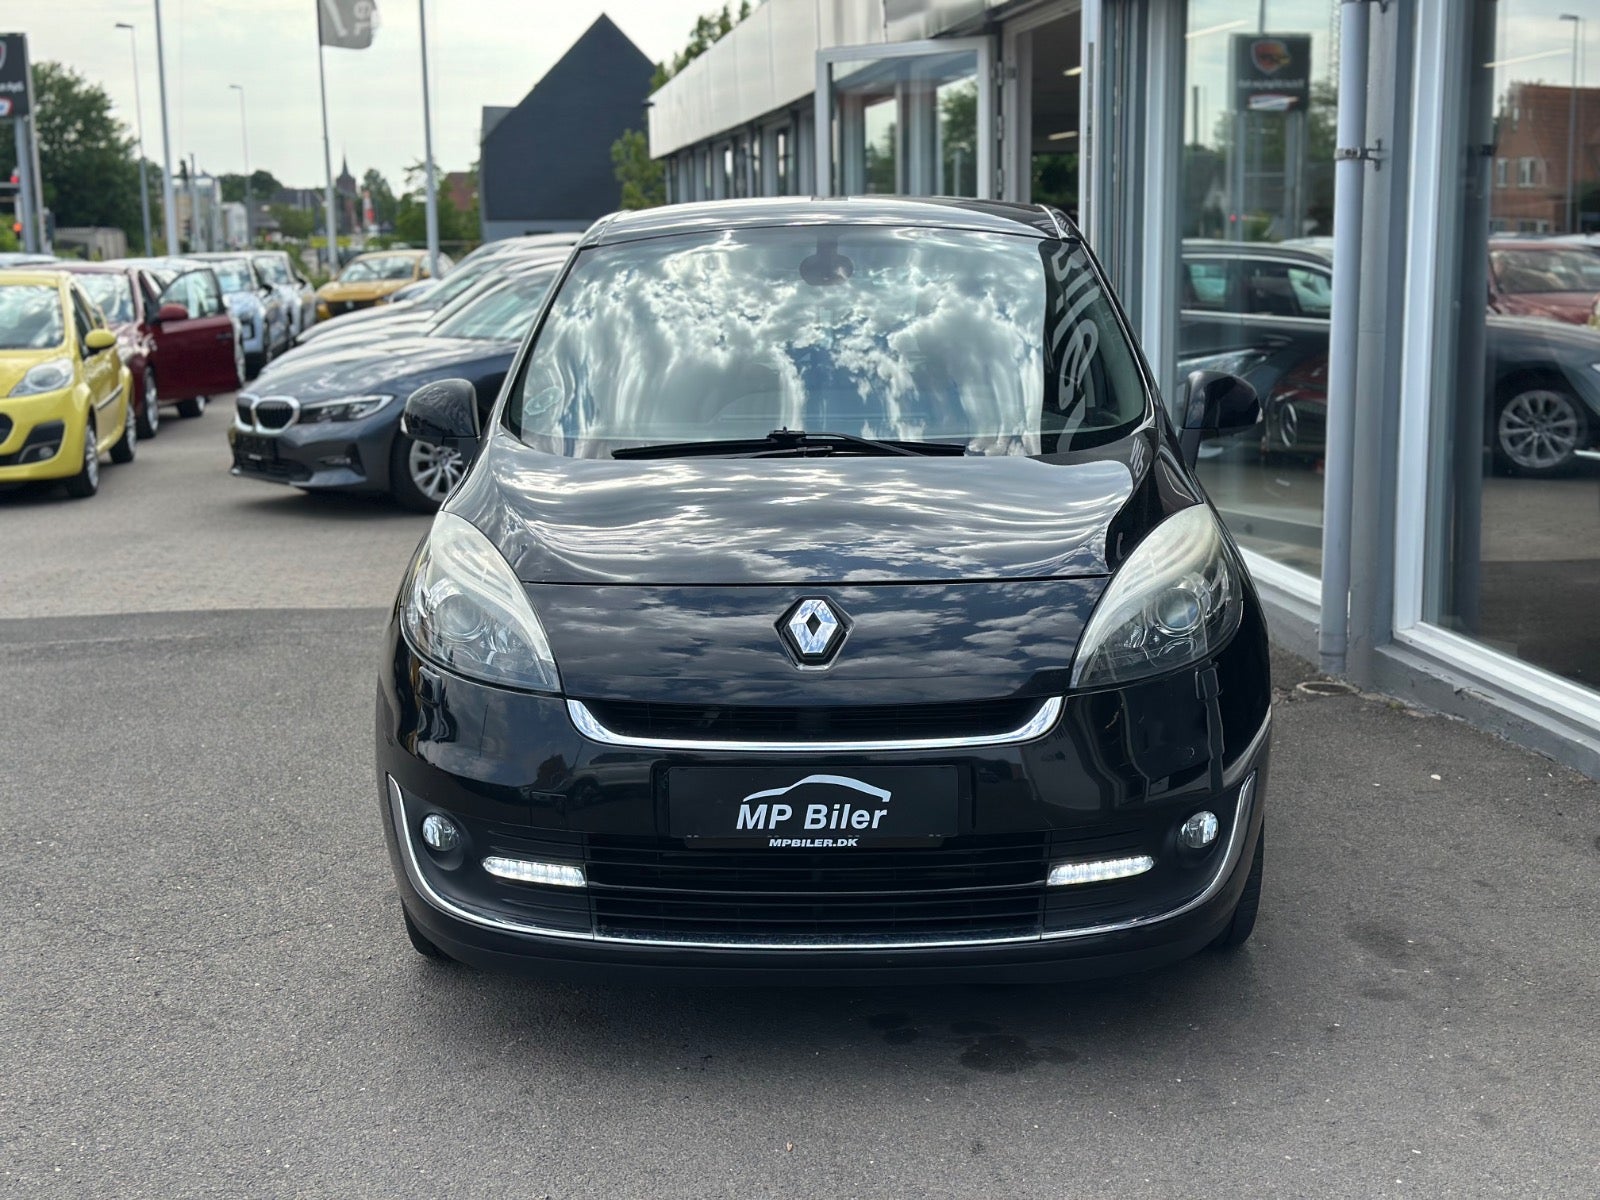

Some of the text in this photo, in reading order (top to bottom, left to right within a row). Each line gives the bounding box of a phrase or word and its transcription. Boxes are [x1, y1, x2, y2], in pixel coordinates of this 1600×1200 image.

[736, 804, 887, 830] MP Biler
[769, 838, 859, 847] MPBILER.DK
